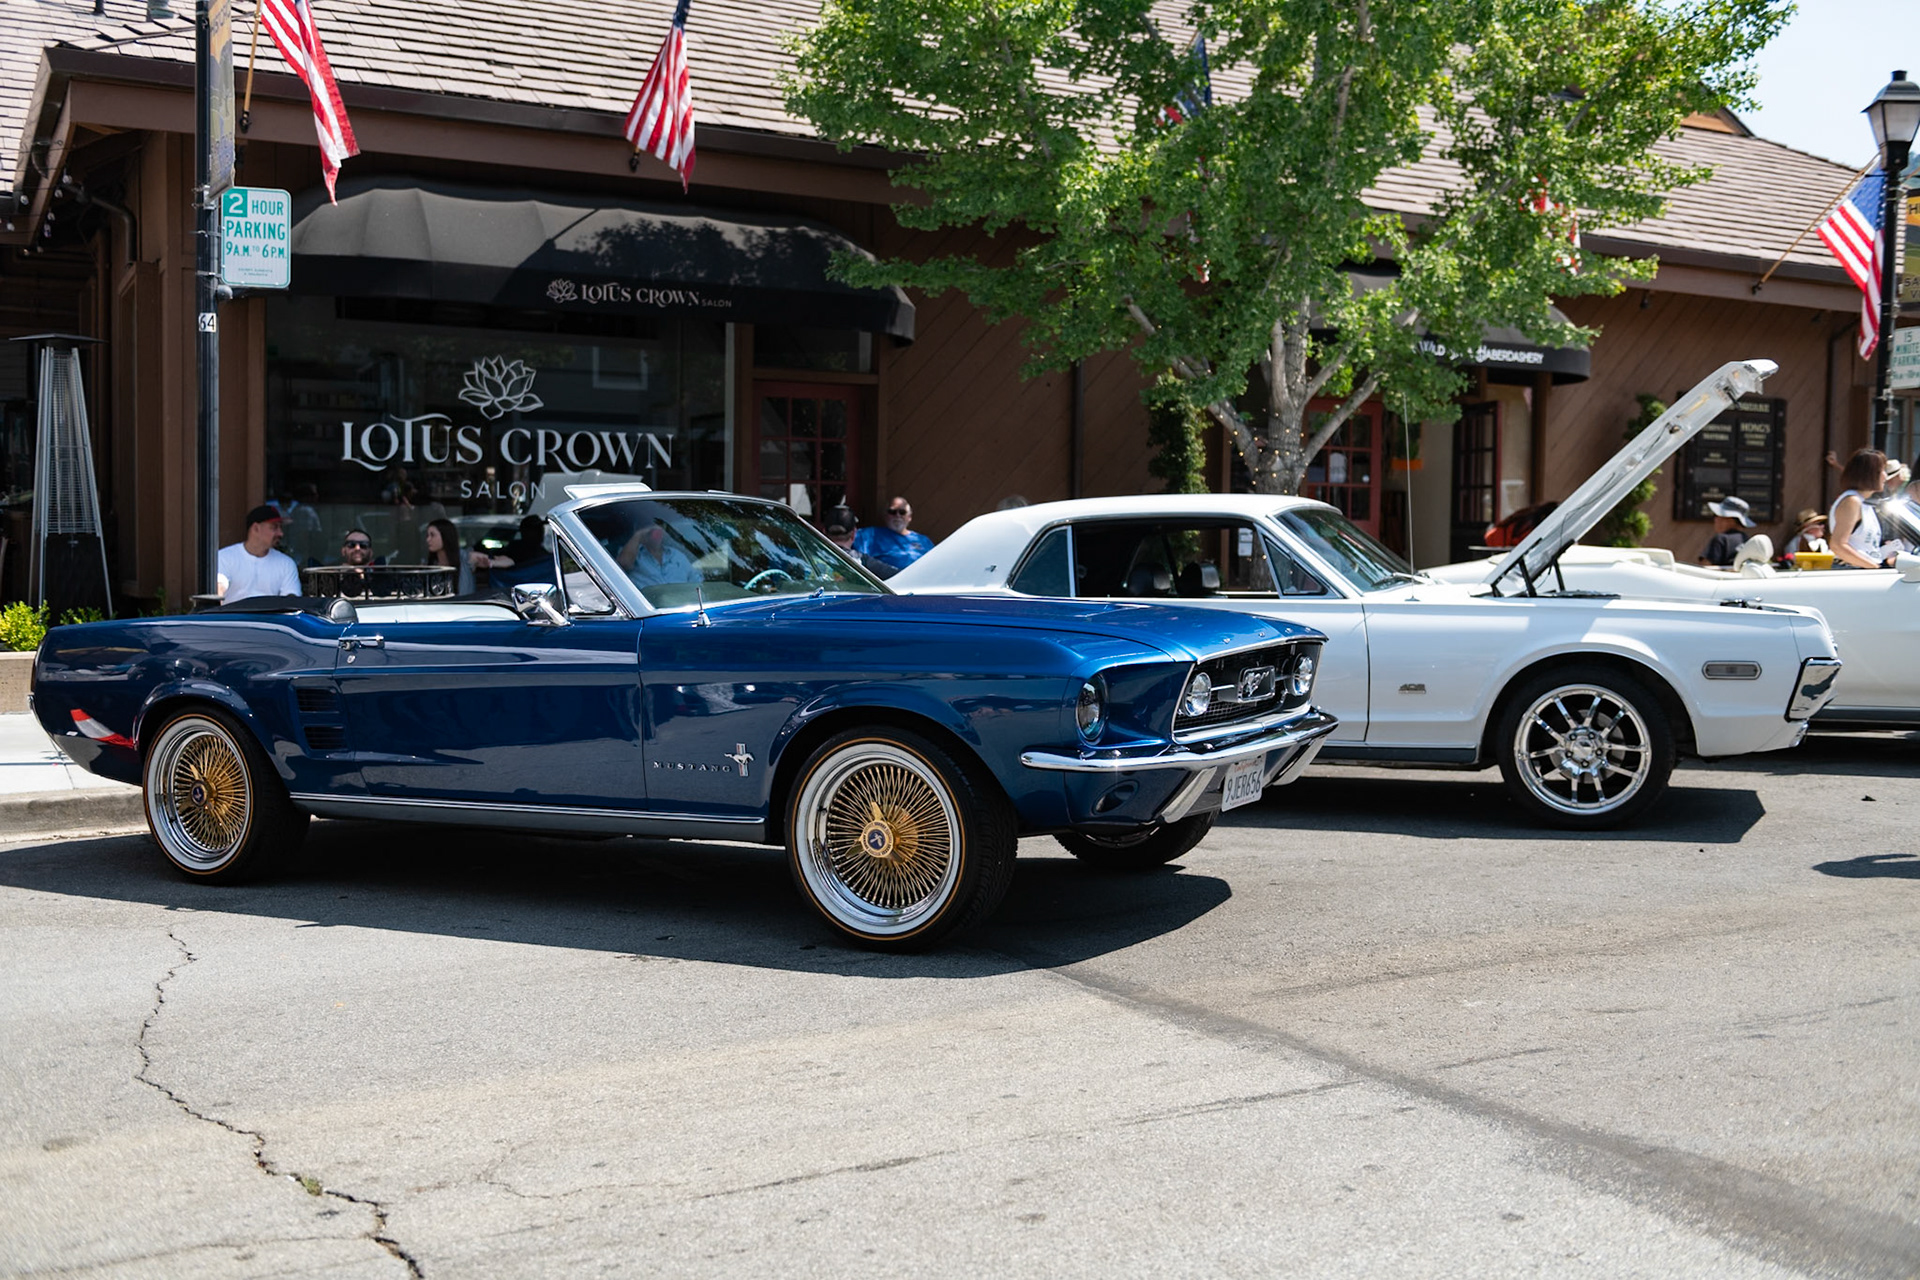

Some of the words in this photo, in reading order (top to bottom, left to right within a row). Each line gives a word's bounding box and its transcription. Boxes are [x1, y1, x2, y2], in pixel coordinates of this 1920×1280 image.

[228, 193, 244, 214] 2
[252, 200, 284, 216] HOUR
[226, 220, 286, 240] PARKING
[582, 282, 631, 304] LOTUS
[636, 288, 699, 308] CROWN
[701, 299, 732, 308] SALON
[200, 315, 215, 330] 64
[1904, 331, 1913, 343] 15
[342, 413, 483, 472] LOTUS
[500, 428, 674, 475] CROWN
[460, 480, 546, 500] SALON
[653, 761, 732, 773] MUSTANG
[1225, 769, 1263, 803] 9JER656
